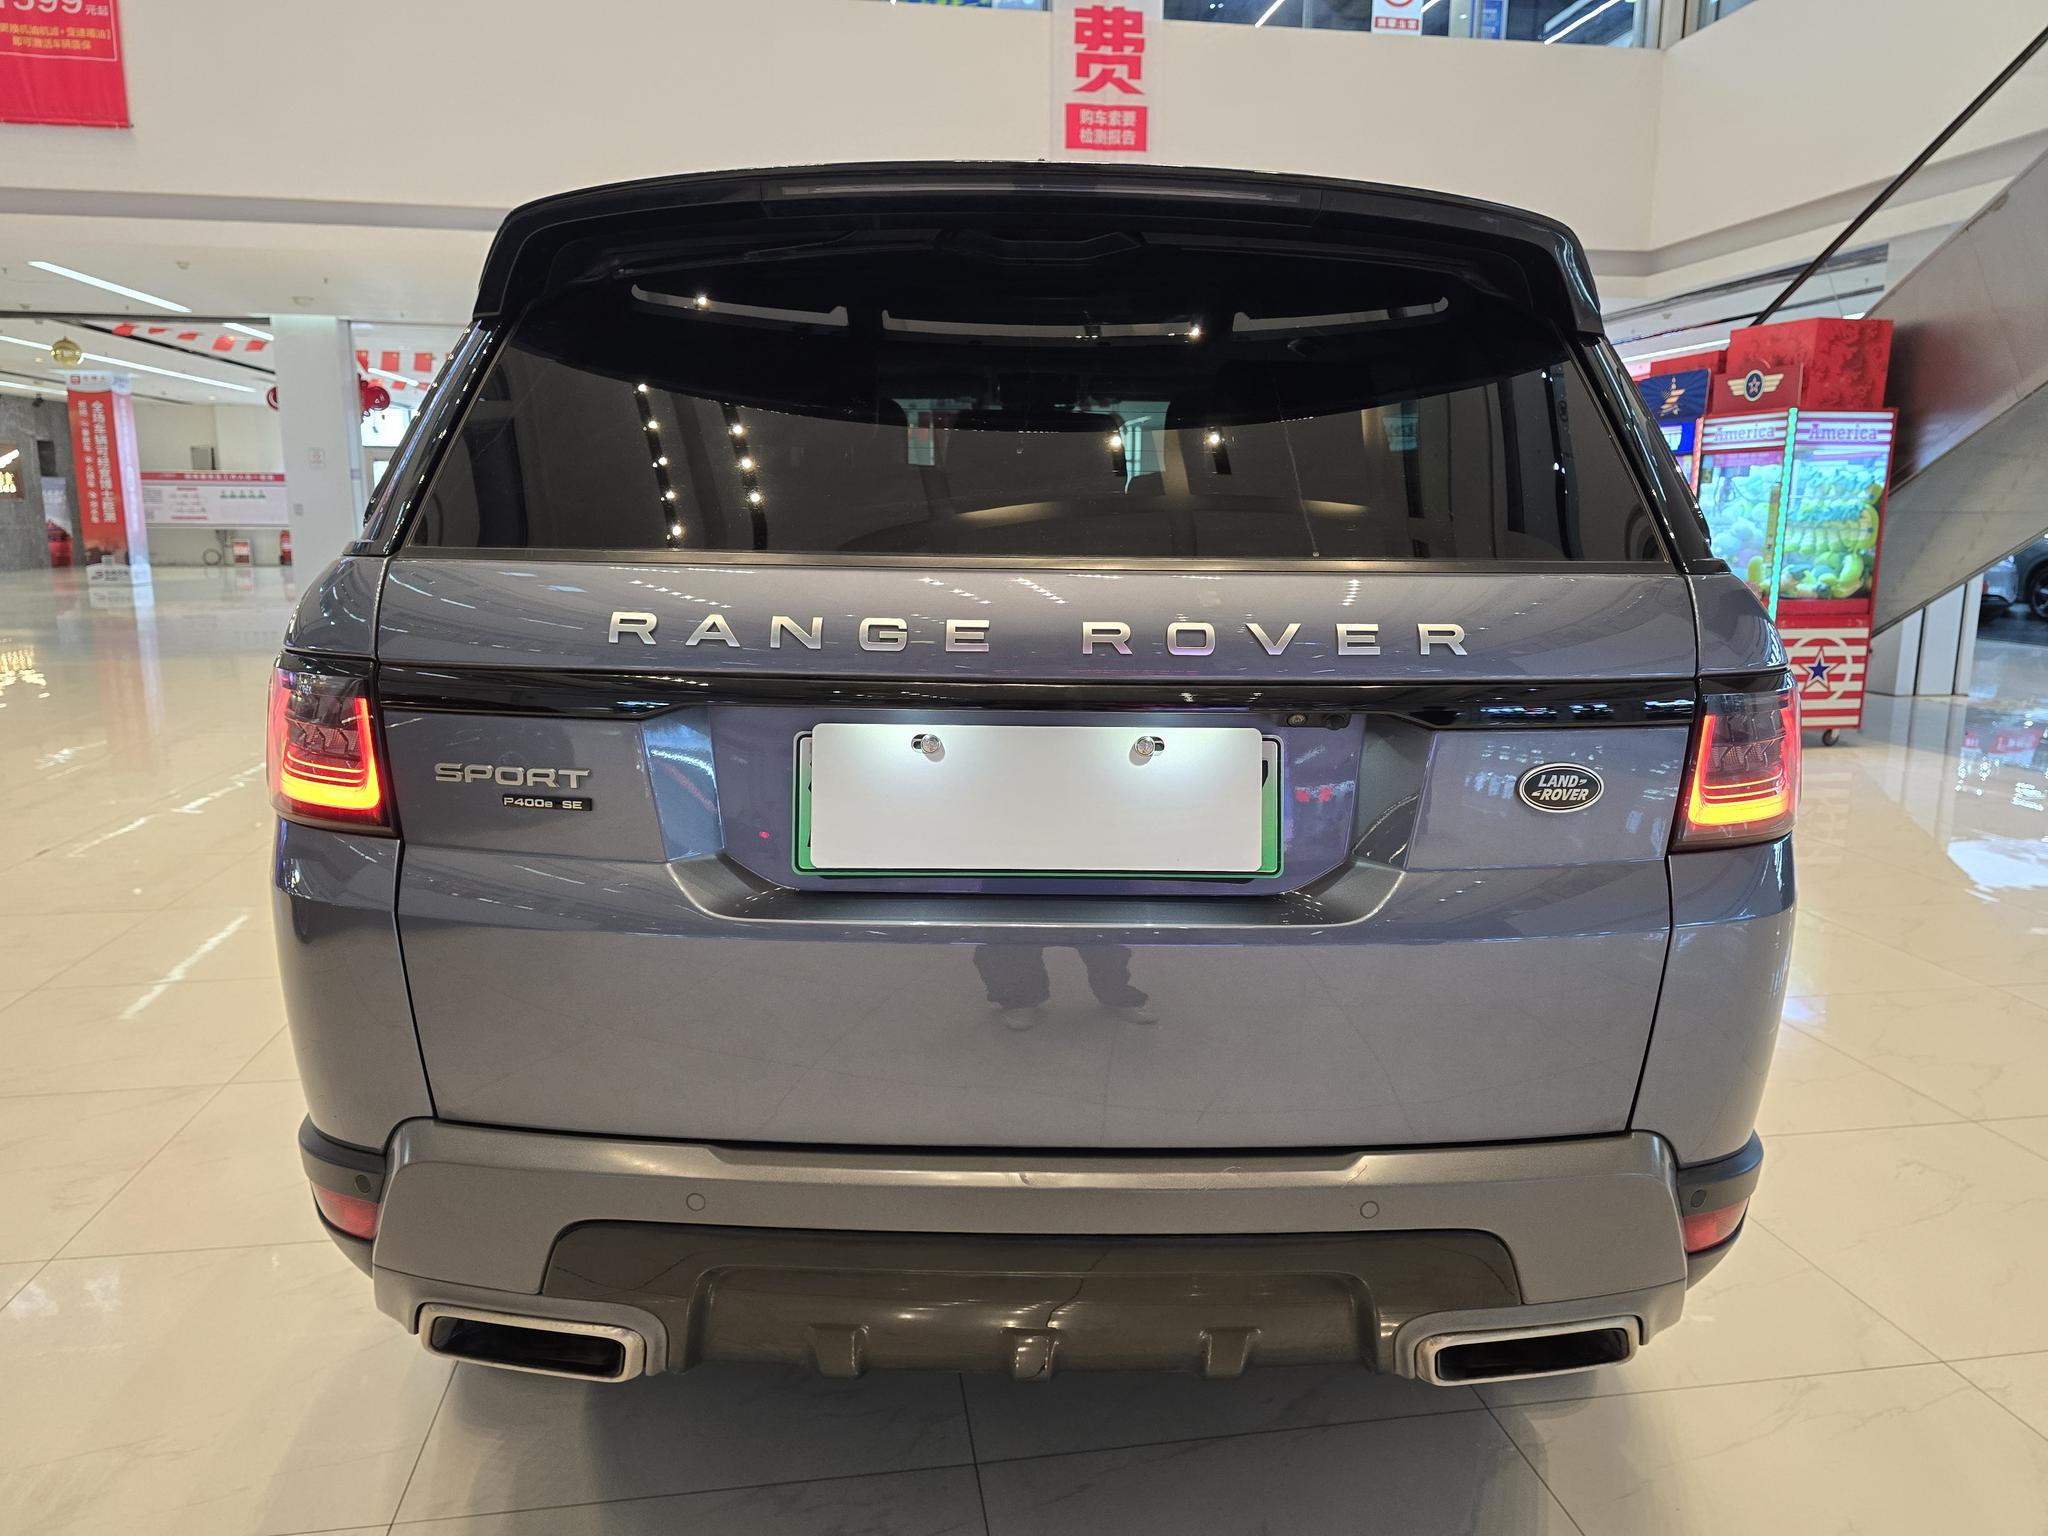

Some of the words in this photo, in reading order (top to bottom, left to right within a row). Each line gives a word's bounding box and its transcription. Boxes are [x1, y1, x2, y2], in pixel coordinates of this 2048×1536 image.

[1073, 5, 1145, 95] 费
[1079, 127, 1136, 146] 检测报告
[1714, 423, 1776, 442] America
[1808, 423, 1878, 441] America
[607, 610, 990, 653] RANGE
[1081, 620, 1468, 656] ROVER
[434, 762, 592, 789] SPORT
[1538, 774, 1579, 788] LAND
[503, 797, 553, 808] P400e
[562, 800, 583, 810] SE
[1539, 788, 1589, 801] ROVER
